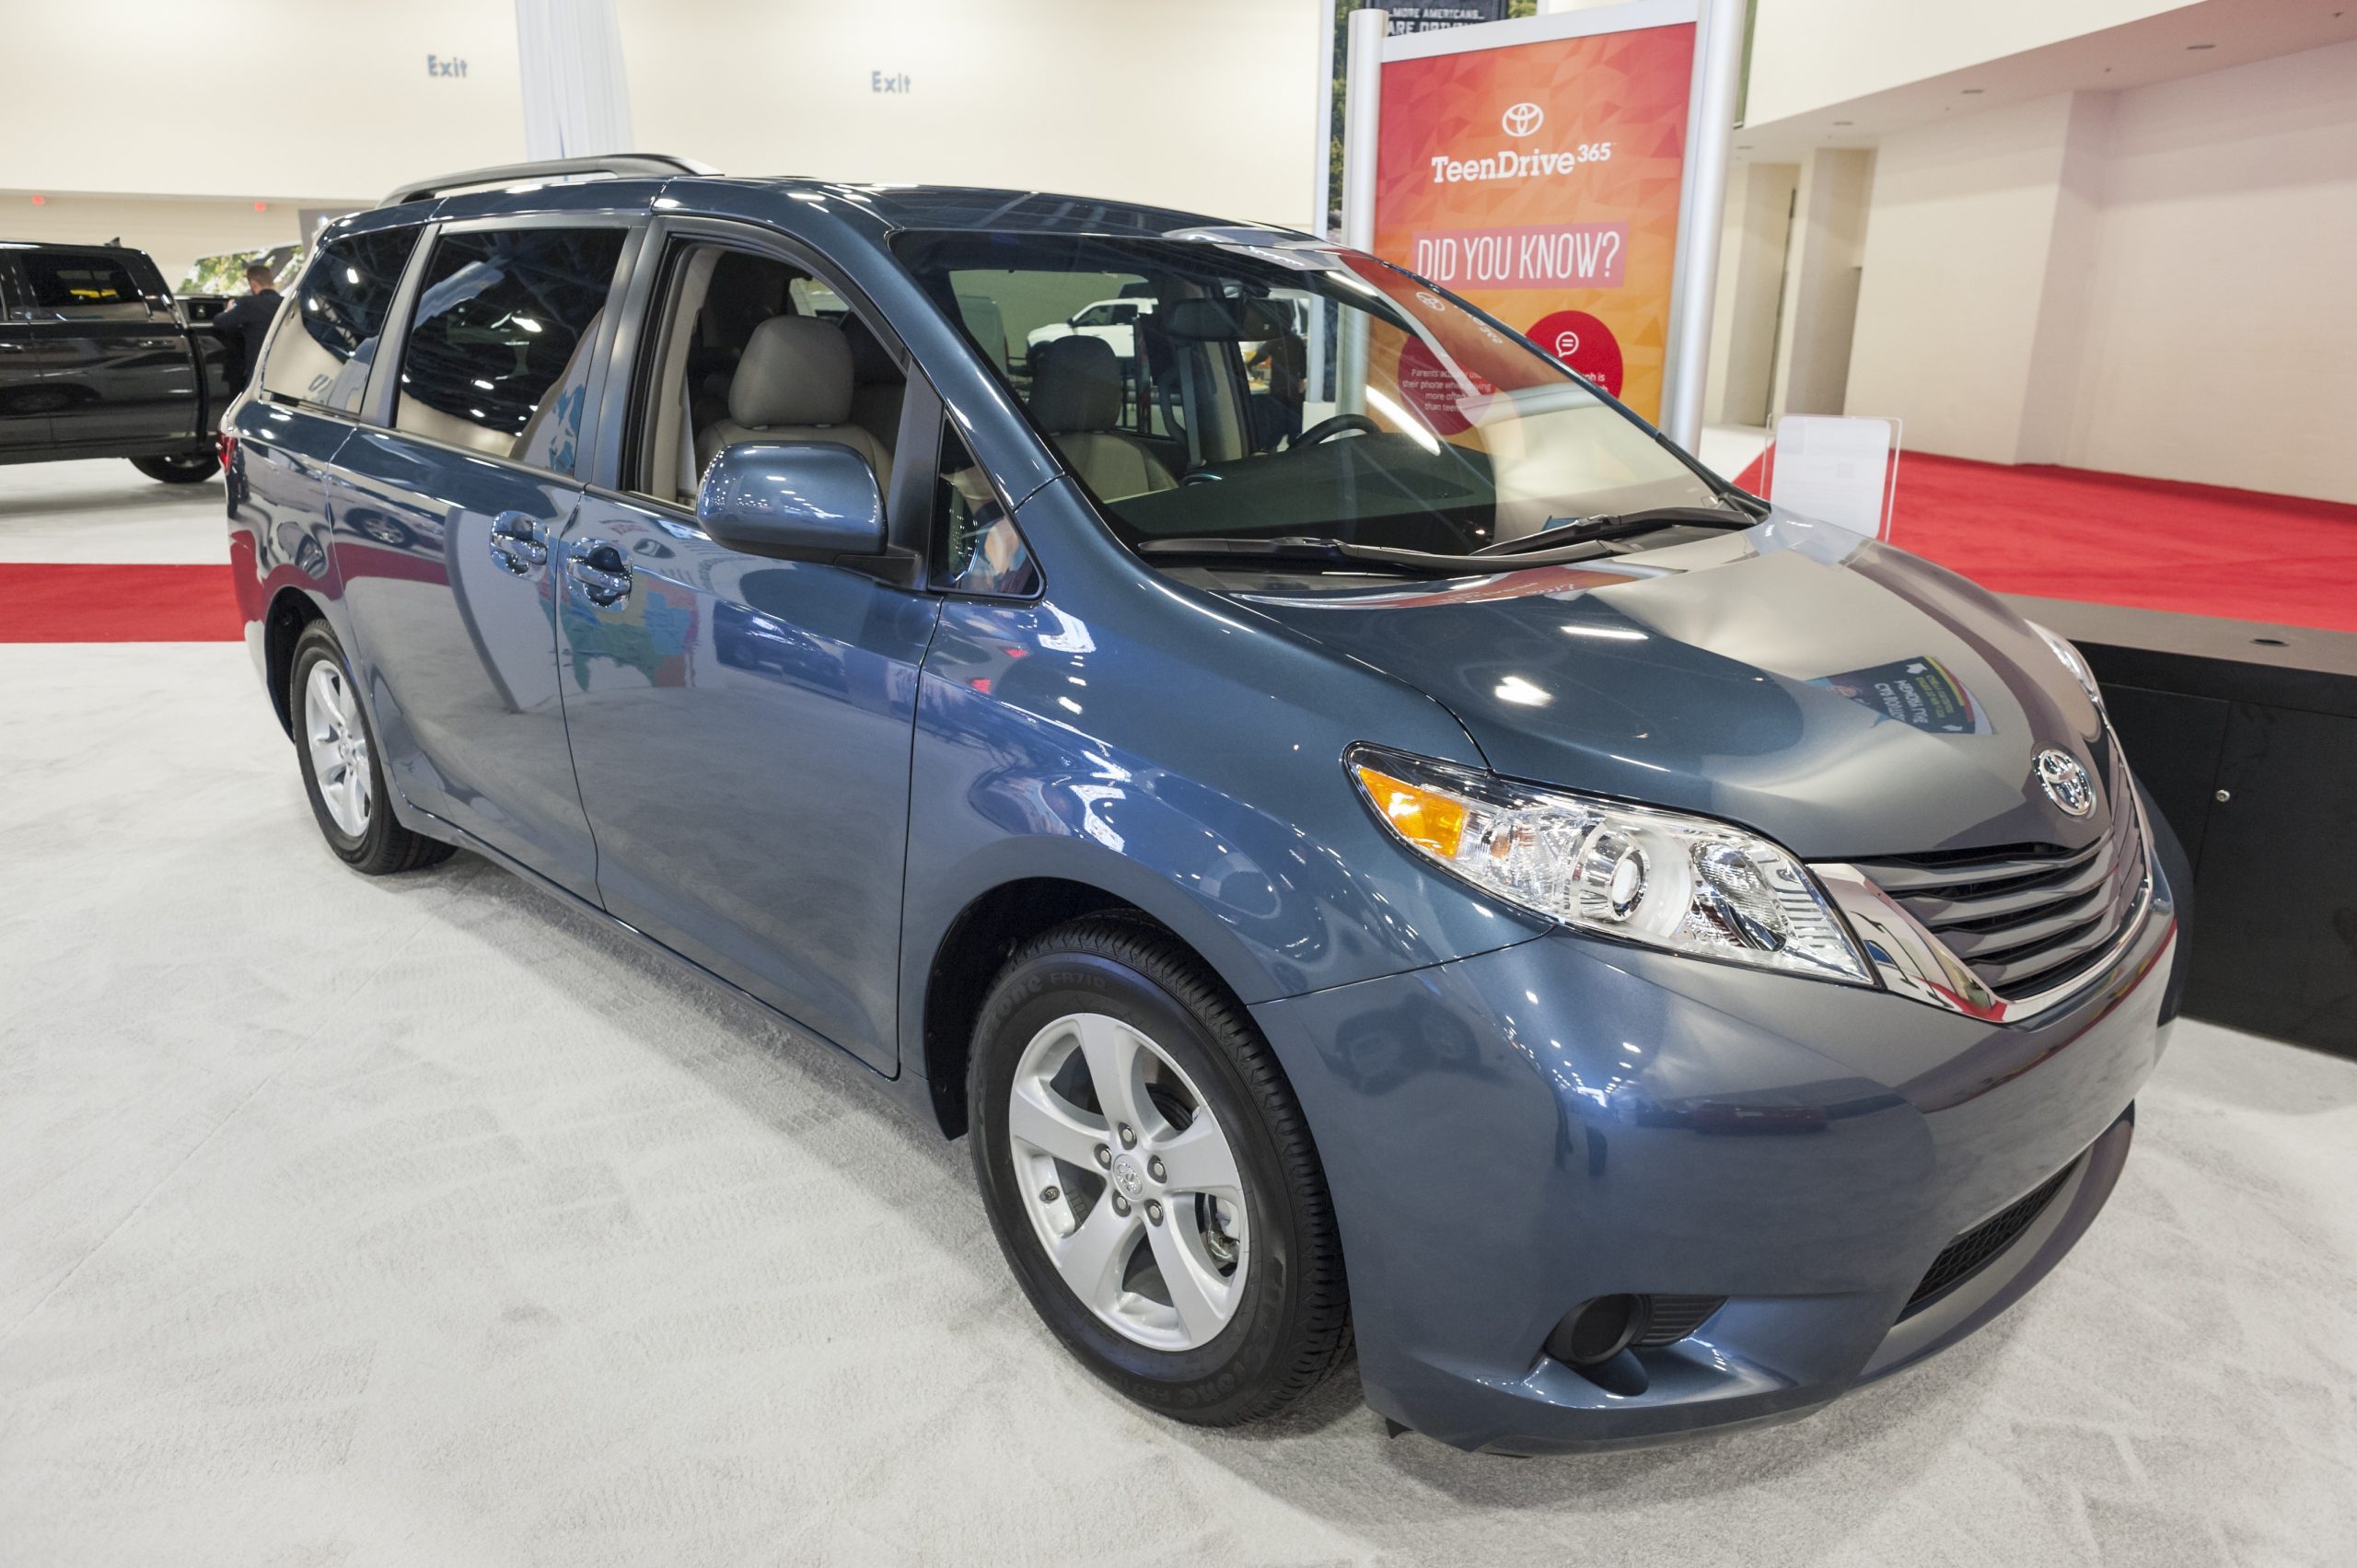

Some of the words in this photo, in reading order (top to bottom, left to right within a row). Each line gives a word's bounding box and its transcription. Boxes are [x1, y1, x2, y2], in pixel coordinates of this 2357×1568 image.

[1387, 20, 1415, 36] ARE
[426, 54, 468, 77] Exit
[871, 70, 911, 93] Exit
[1418, 238, 1457, 282] DID
[1464, 235, 1513, 281] YOU
[1519, 231, 1620, 280] KNOW?
[1402, 380, 1419, 389] their
[1421, 381, 1445, 389] phone
